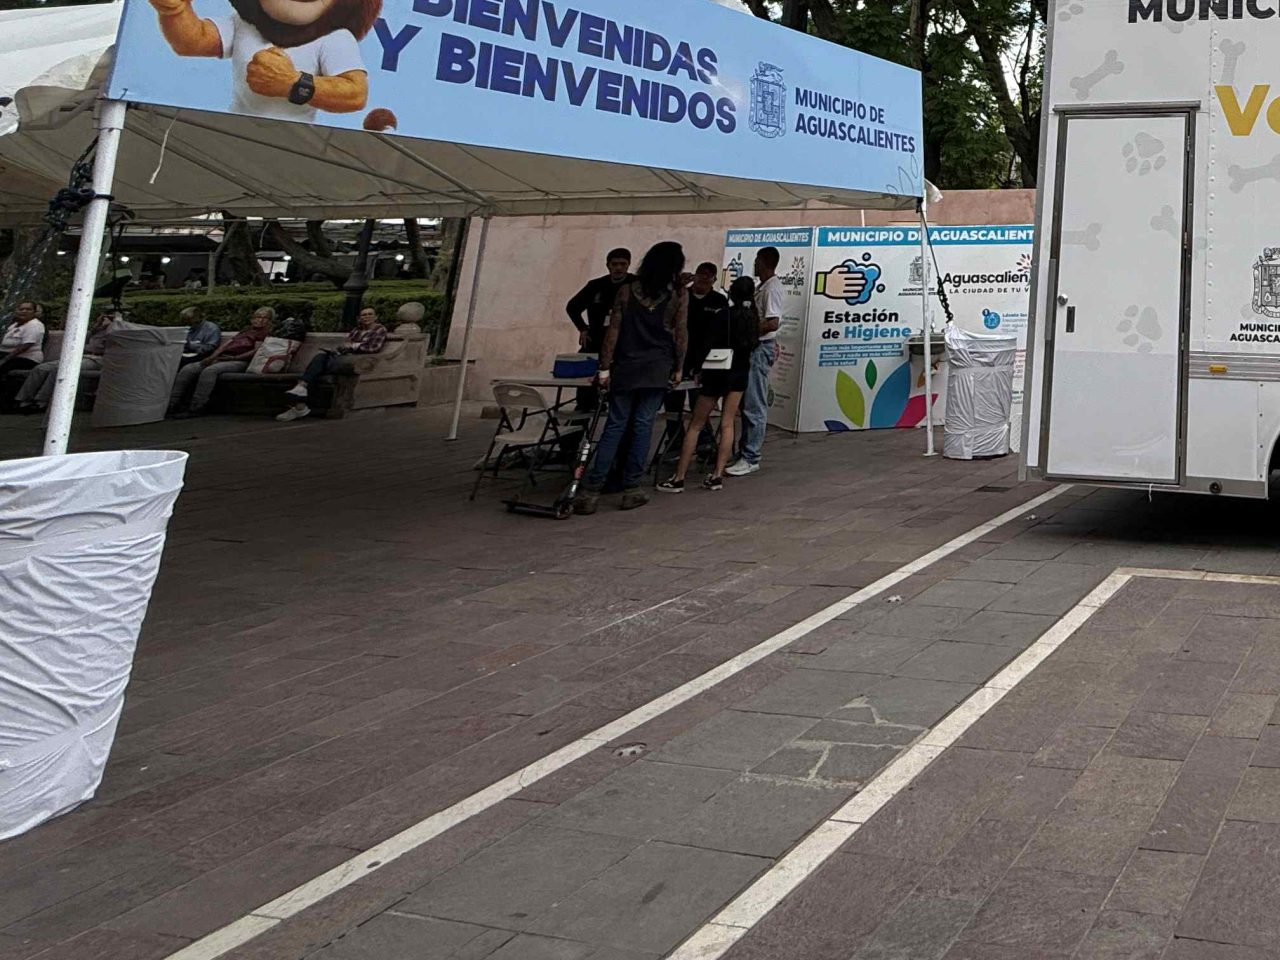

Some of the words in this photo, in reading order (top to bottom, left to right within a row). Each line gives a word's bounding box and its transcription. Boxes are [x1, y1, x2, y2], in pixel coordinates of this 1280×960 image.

[371, 18, 422, 72] Y
[435, 33, 737, 134] BIENVENIDOS
[795, 87, 867, 120] MUNICIPIO
[869, 105, 885, 125] DE
[795, 113, 916, 154] AGUASCALIENTES
[827, 231, 905, 242] MUNICIPIO
[823, 308, 899, 324] Estación
[822, 328, 840, 340] de
[844, 324, 912, 342] Higiene
